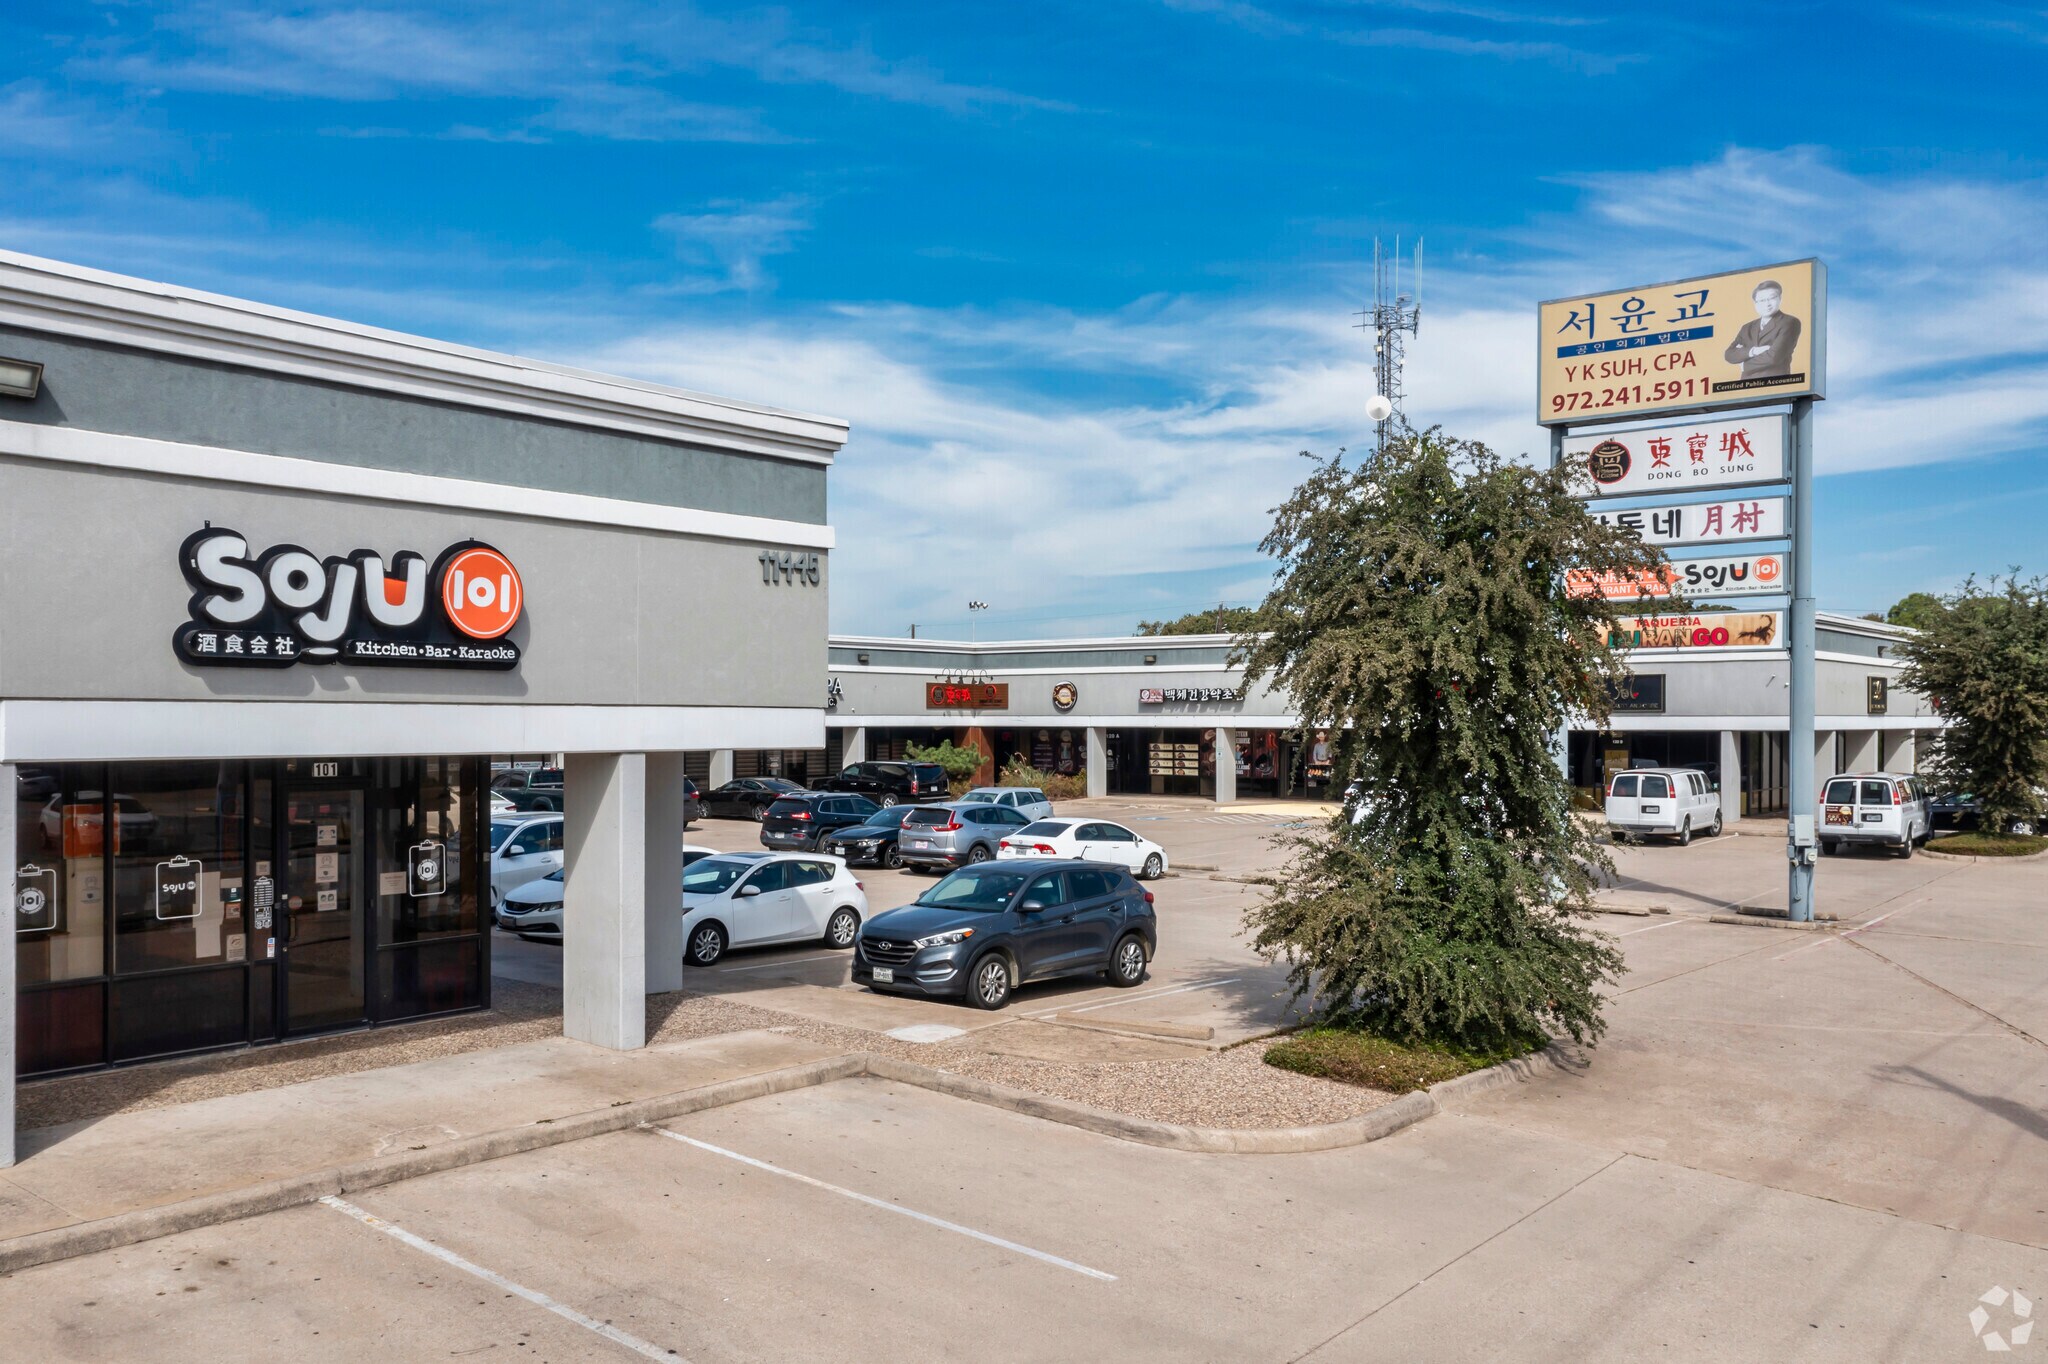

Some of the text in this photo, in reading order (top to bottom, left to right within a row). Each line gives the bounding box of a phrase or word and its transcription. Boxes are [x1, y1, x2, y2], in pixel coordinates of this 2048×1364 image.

[1557, 290, 1715, 340] 서윤교
[1565, 351, 1697, 382] Y K SUH, CPA
[1552, 377, 1709, 413] 972.241.5911
[1716, 376, 1802, 391] Certified Public Accountant
[1648, 463, 1754, 480] DONG BO SUNG
[1593, 509, 1681, 540] 동네
[1700, 502, 1765, 536] 月村
[758, 550, 819, 584] 11445
[198, 633, 294, 655] 酒食会社
[315, 764, 337, 776] 101
